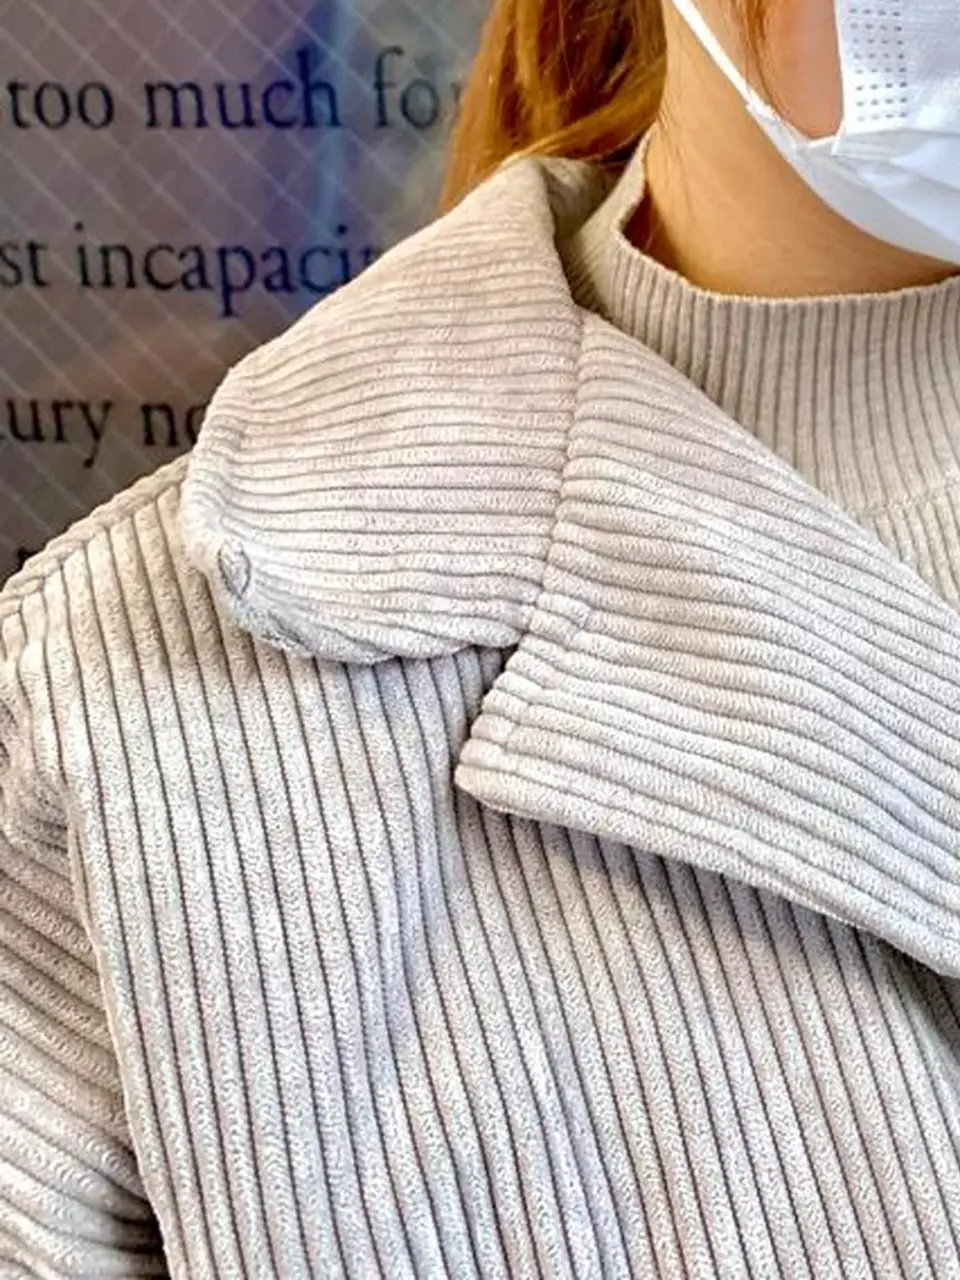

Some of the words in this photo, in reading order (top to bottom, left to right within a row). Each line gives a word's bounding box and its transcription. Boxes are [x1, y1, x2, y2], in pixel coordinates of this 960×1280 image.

[6, 76, 115, 130] too
[144, 50, 341, 131] much
[372, 45, 463, 131] fo
[0, 238, 52, 288] st
[74, 221, 380, 318] incapaci
[0, 396, 114, 470] ury
